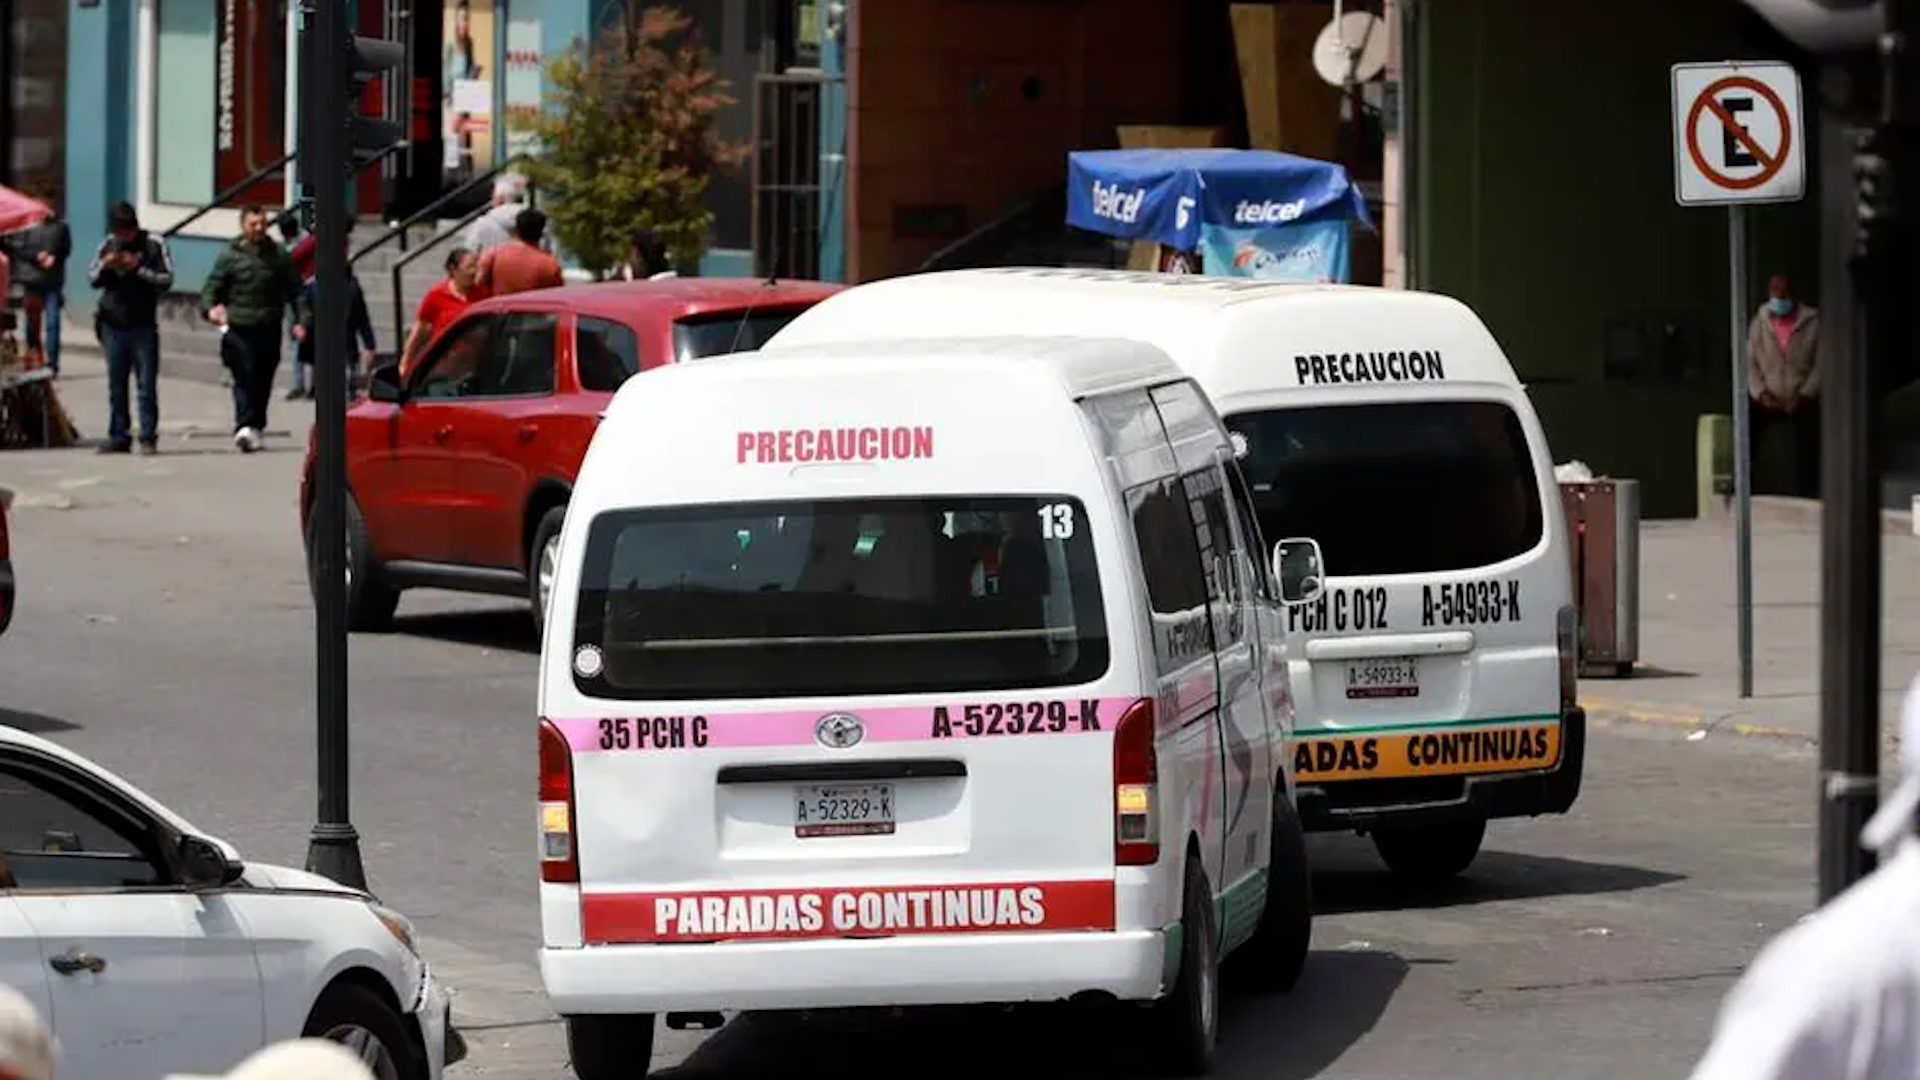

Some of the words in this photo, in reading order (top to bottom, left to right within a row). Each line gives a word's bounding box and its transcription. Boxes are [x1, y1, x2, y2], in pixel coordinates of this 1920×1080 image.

[1721, 98, 1757, 167] E
[1092, 180, 1145, 223] telcel
[1235, 198, 1306, 223] telcel
[1295, 351, 1445, 384] PRECAUCION
[737, 427, 934, 463] PRECAUCION
[1038, 504, 1074, 539] 13
[1334, 588, 1347, 631] C
[1354, 587, 1388, 630] 012
[1422, 580, 1521, 627] A-54933-K
[1349, 665, 1418, 685] A-54933-K
[599, 718, 630, 748] 35
[637, 717, 683, 748] PCH
[692, 717, 708, 747] C
[931, 700, 1101, 738] A-52329-K
[1295, 739, 1379, 773] ADAS
[1407, 728, 1548, 766] CONTINUAS
[797, 797, 892, 821] A-52329-K
[654, 892, 823, 934] PARADAS
[832, 886, 1044, 930] CONTINUAS
